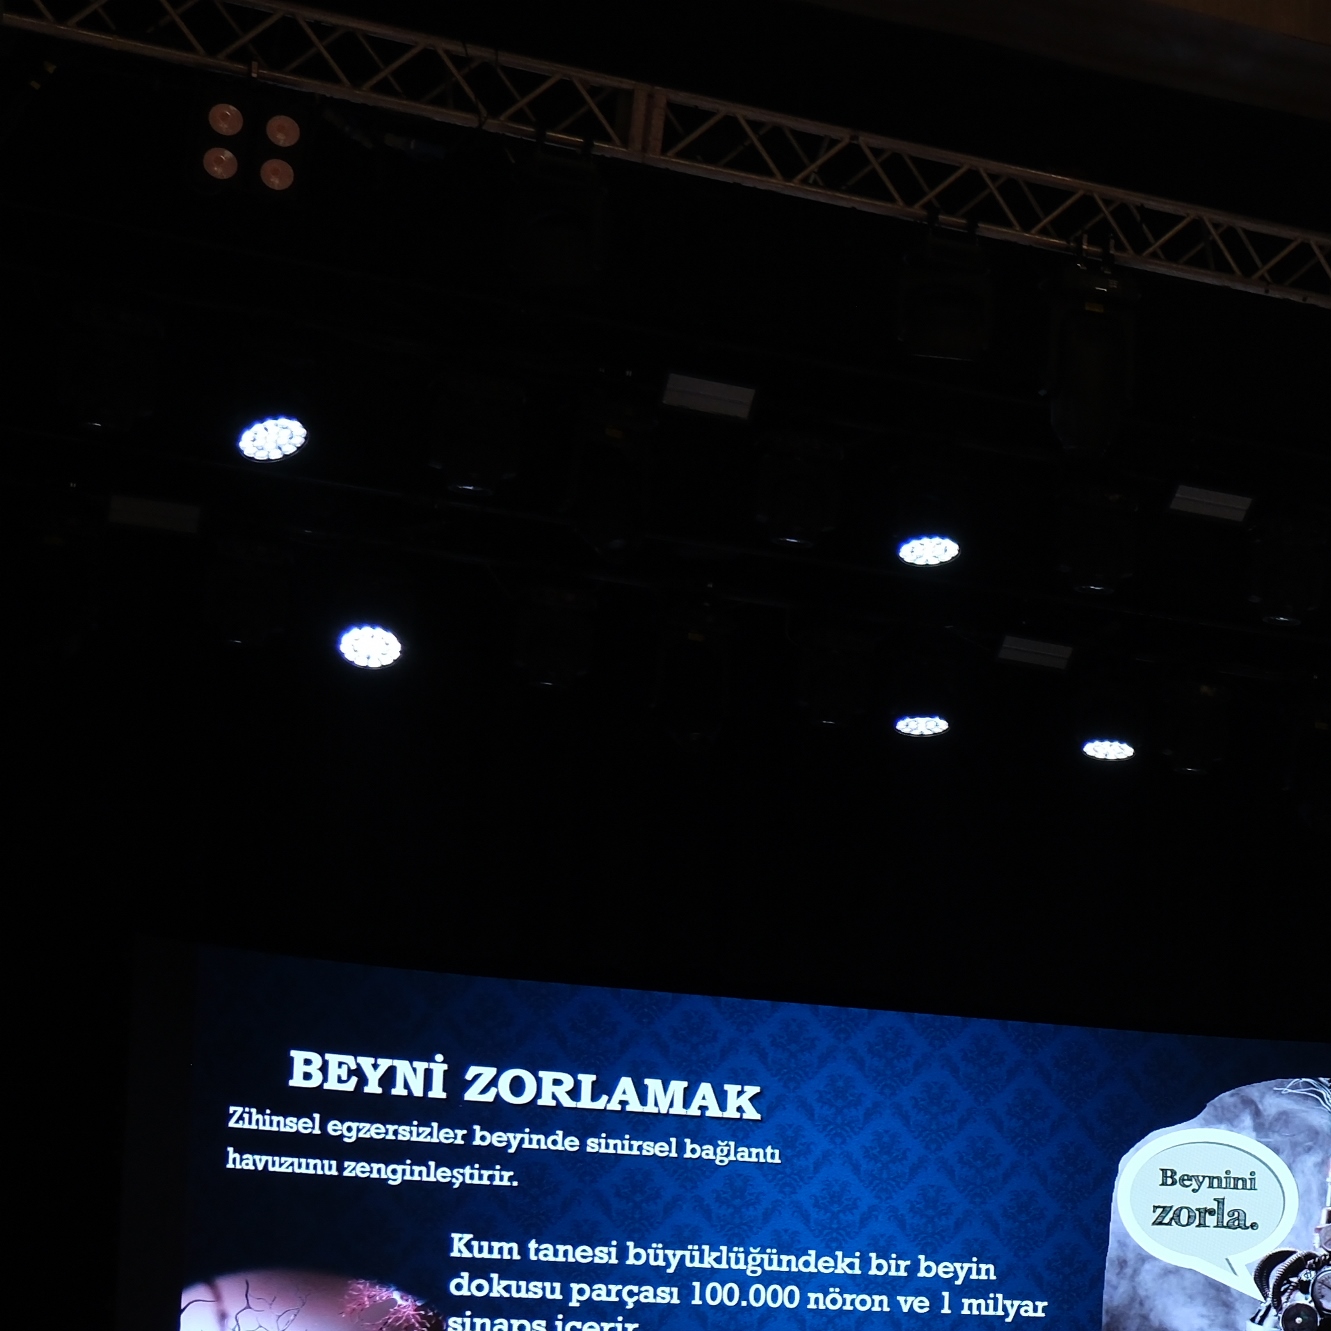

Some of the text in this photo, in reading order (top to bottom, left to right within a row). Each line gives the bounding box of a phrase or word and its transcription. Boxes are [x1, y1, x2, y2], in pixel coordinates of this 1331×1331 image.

[288, 1049, 762, 1120] BEYNİ ZORLAMAK
[227, 1105, 782, 1166] Zihinsel egzersizler beyinde sinirsel bağlantı
[225, 1146, 519, 1189] havuzunu zenginleştirir.
[1159, 1167, 1257, 1193] Beynini
[1151, 1196, 1259, 1230] zorla.
[450, 1232, 997, 1286] Kum tanesi büyüklüğündeki bir beyin
[449, 1271, 1049, 1323] dokusu parçası 100.000 nöron ve 1 milyar
